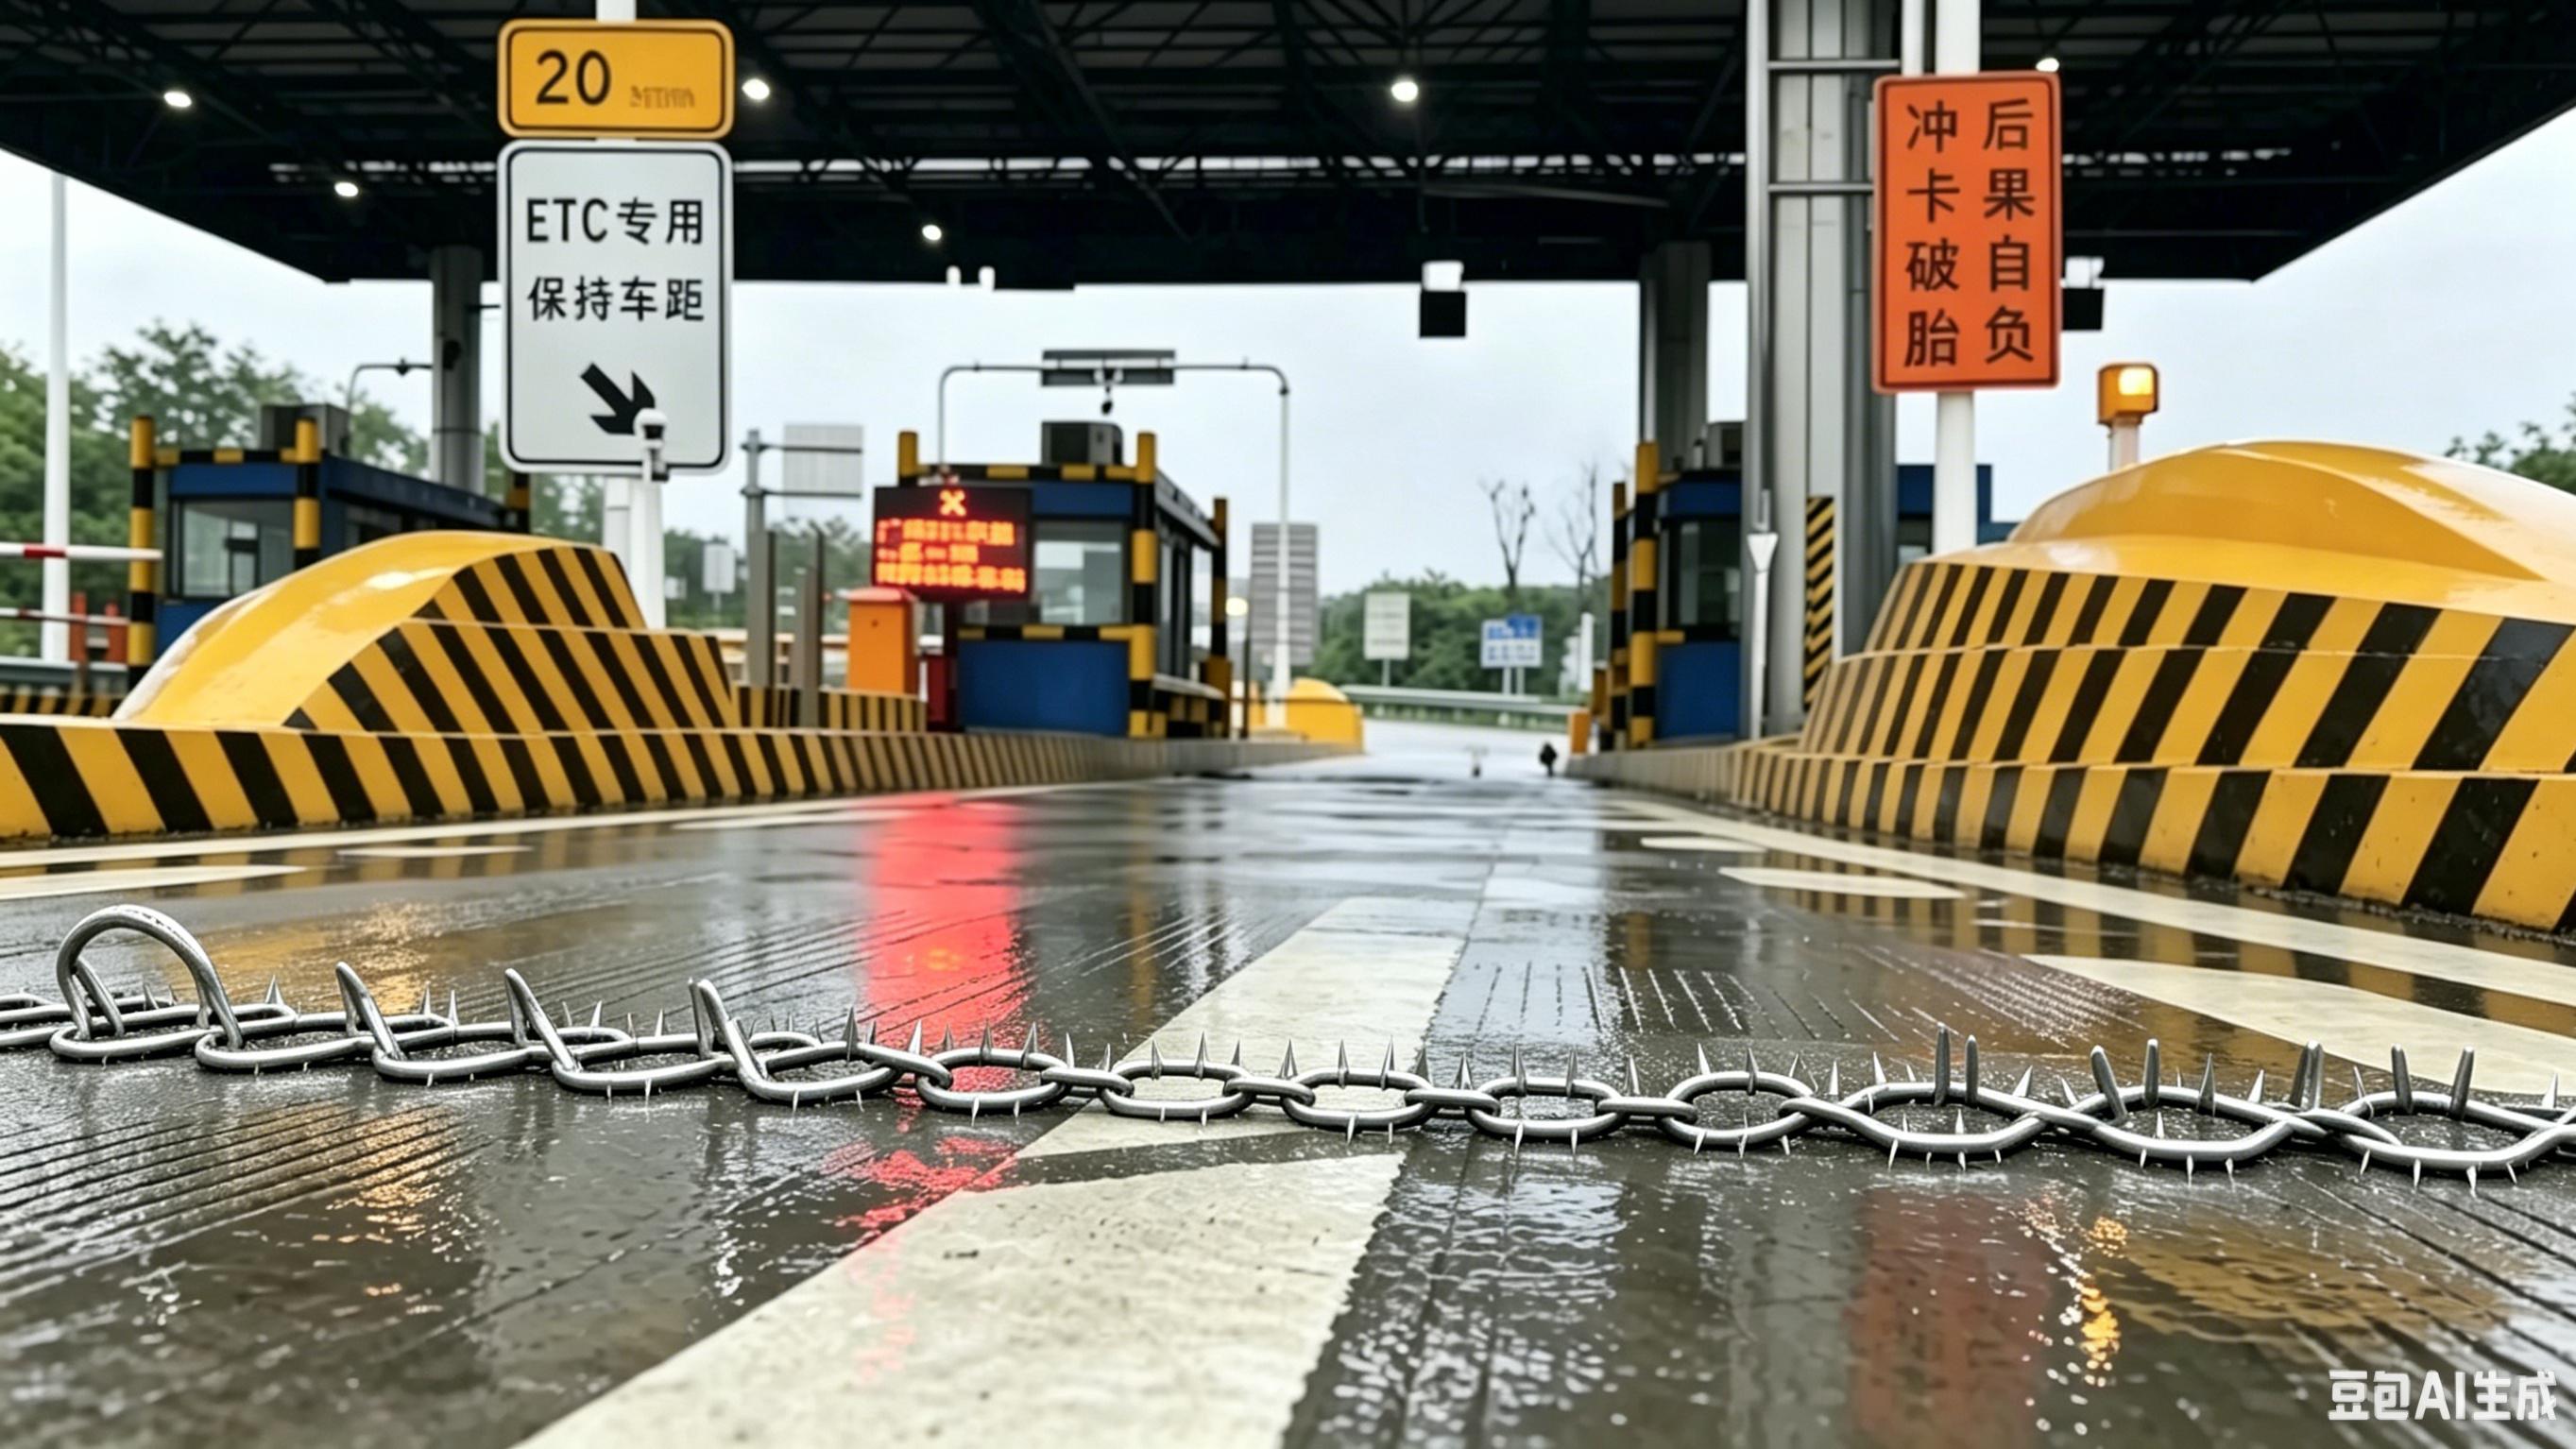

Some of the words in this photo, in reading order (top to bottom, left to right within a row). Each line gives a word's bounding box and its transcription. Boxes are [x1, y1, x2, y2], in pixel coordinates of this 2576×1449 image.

[536, 49, 612, 106] 20
[527, 196, 703, 246] ETC专用
[1904, 99, 1960, 368] 冲卡破胎
[1982, 98, 2035, 365] 后果自负
[526, 275, 705, 322] 保持车距
